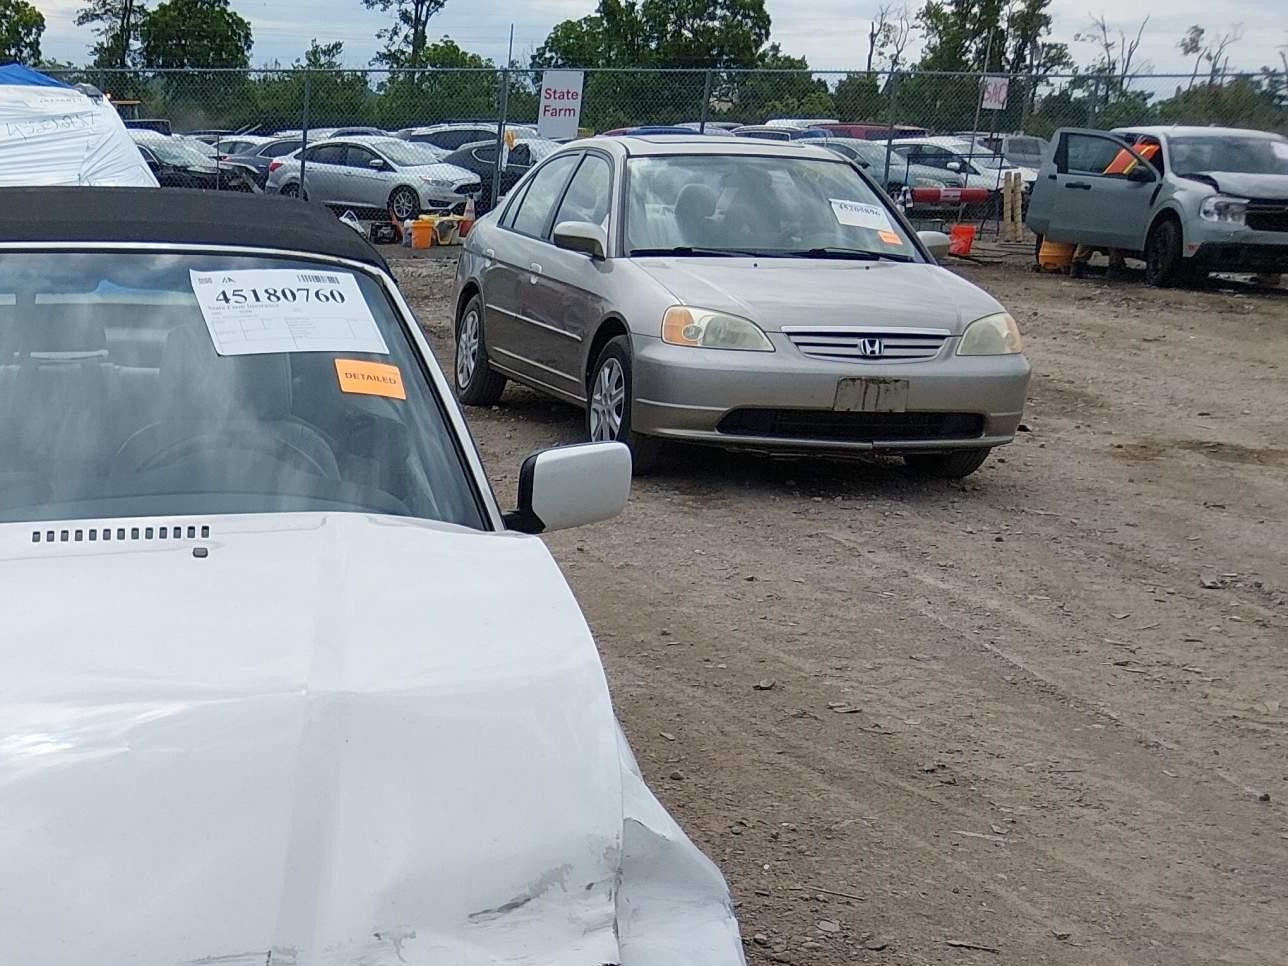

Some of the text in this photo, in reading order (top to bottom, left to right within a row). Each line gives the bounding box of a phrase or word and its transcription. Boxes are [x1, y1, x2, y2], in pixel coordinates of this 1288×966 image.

[544, 88, 579, 100] State
[543, 105, 576, 117] Farm
[215, 287, 346, 304] 45180760
[345, 372, 397, 385] DETAILED
